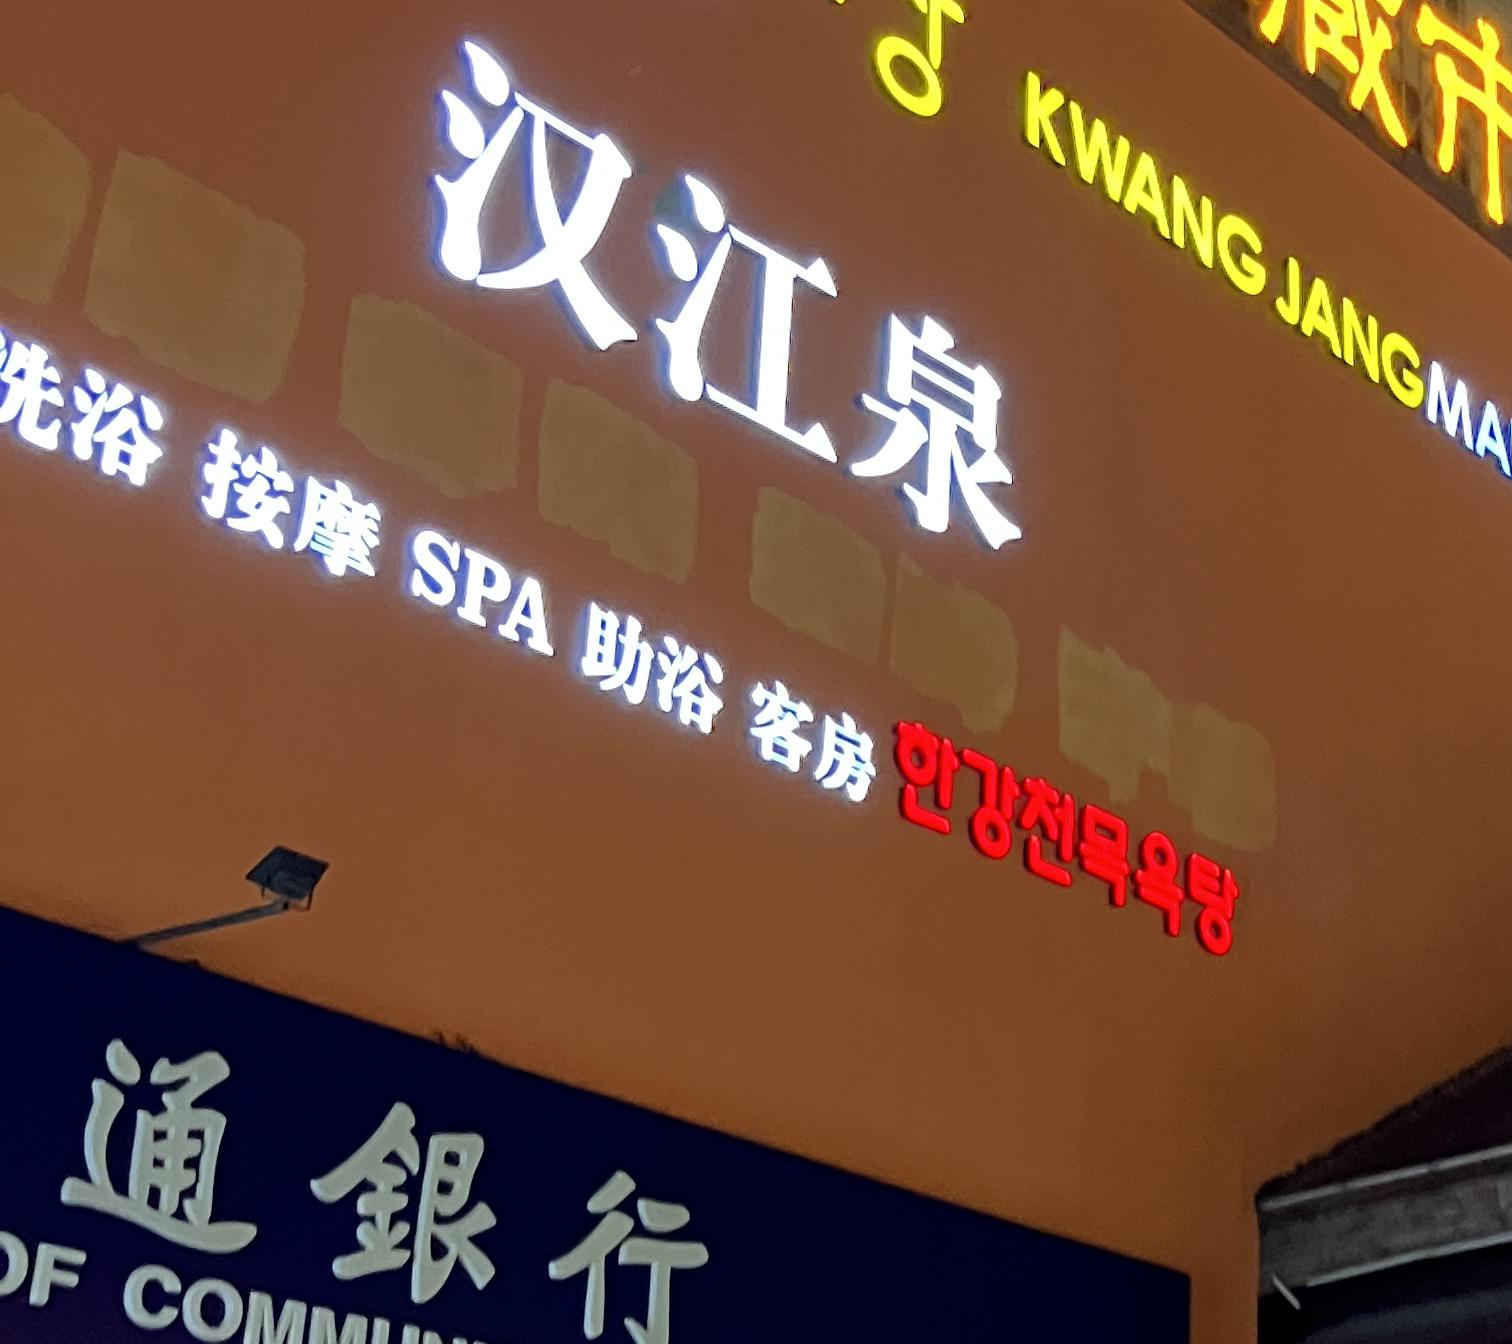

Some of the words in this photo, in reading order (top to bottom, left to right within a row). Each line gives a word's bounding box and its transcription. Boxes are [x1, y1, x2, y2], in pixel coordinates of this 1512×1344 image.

[433, 40, 1023, 550] 汉江泉
[1025, 70, 1267, 297] KWANG
[1274, 258, 1426, 410] JANG
[0, 328, 164, 487] 洗浴
[200, 428, 381, 578] 按摩
[409, 529, 554, 657] SPA
[581, 600, 725, 735] 助浴
[749, 680, 878, 803] 客房
[893, 719, 1241, 957] 한강천목욕탕
